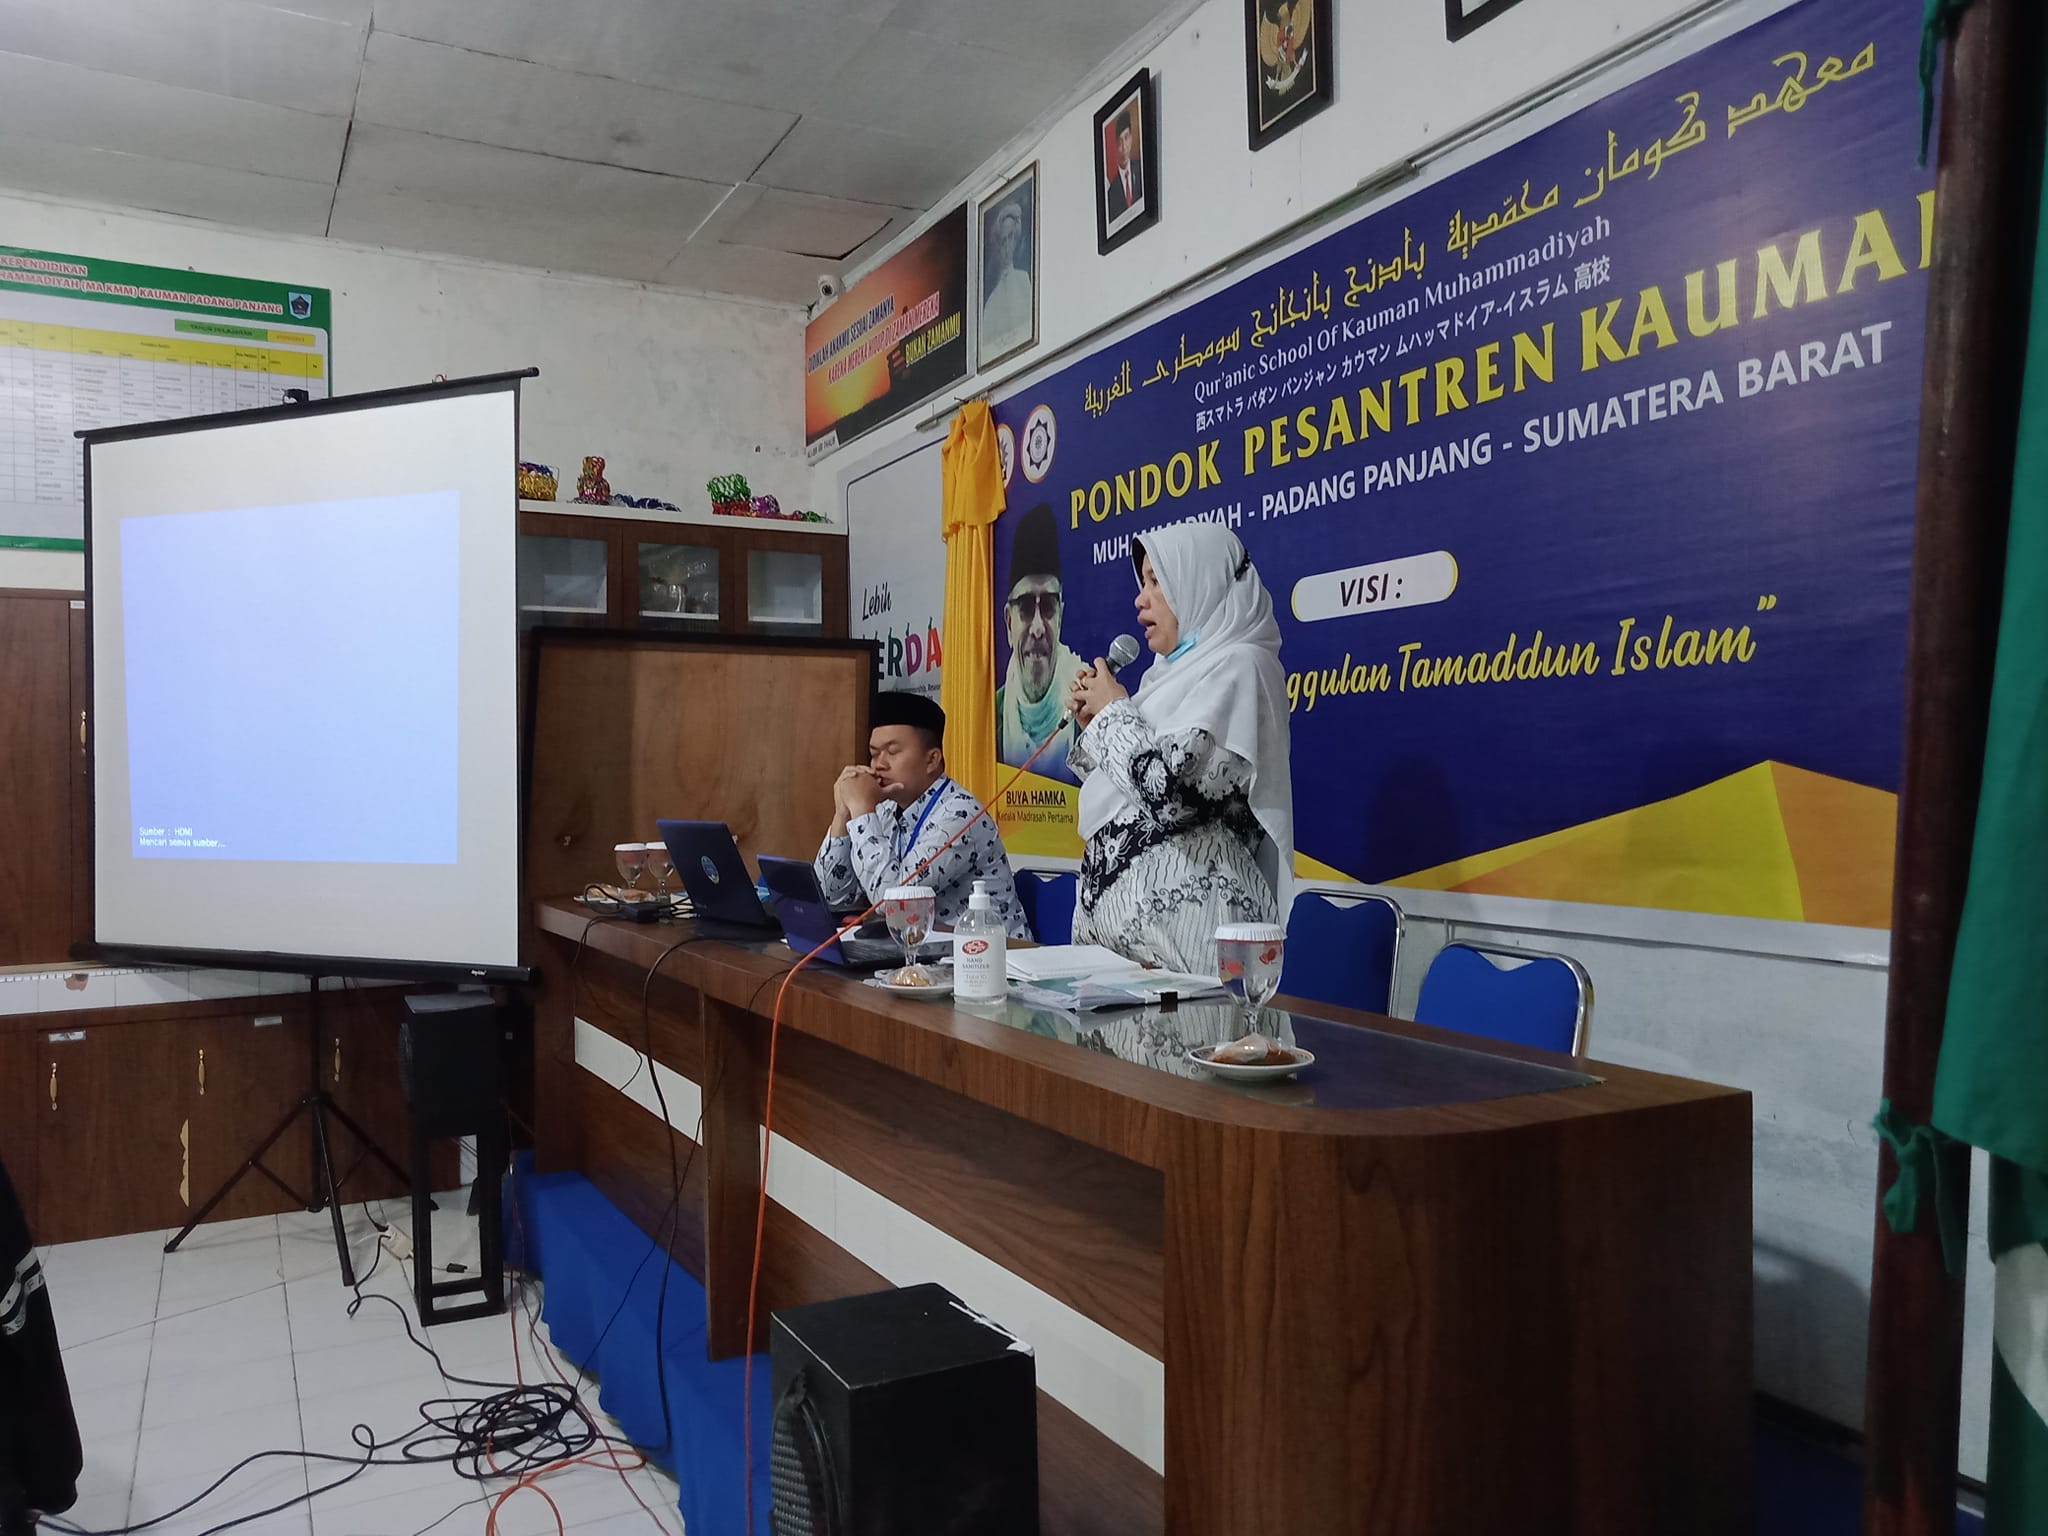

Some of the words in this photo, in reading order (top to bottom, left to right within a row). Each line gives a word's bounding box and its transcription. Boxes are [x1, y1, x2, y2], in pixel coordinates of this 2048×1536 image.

[0, 257, 87, 276] KEPENDIDIKAN
[1574, 255, 1610, 294] 高校
[139, 287, 186, 303] KAUMAN
[189, 295, 233, 309] PADANG
[235, 301, 283, 314] PANJANG
[1259, 336, 1312, 375] School
[1317, 325, 1338, 351] Of
[1343, 297, 1419, 342] Kauman
[1425, 216, 1610, 309] Muhammadiyah
[906, 332, 926, 367] BUKAN
[927, 311, 961, 352] ZAMANMU
[1070, 440, 1222, 530] PONDOK
[1244, 322, 1555, 476] PESANTREN
[1093, 502, 1242, 565] MUHYAH
[1262, 470, 1356, 521] PADANG
[1363, 432, 1492, 495] PANJANG
[1523, 370, 1724, 454] SUMATERA
[1738, 320, 1893, 399] BARAT
[862, 581, 892, 621] Lebih
[1339, 573, 1389, 608] VISI
[1399, 630, 1600, 692] Tamaddun
[1006, 790, 1029, 805] BUYA
[1030, 790, 1067, 806] HAMKA
[139, 826, 165, 837] Sumber
[174, 826, 193, 837] HDMI
[1017, 810, 1047, 823] Madrasah
[1048, 811, 1074, 824] Pertama
[139, 837, 167, 847] Mencari
[169, 838, 191, 847] semua
